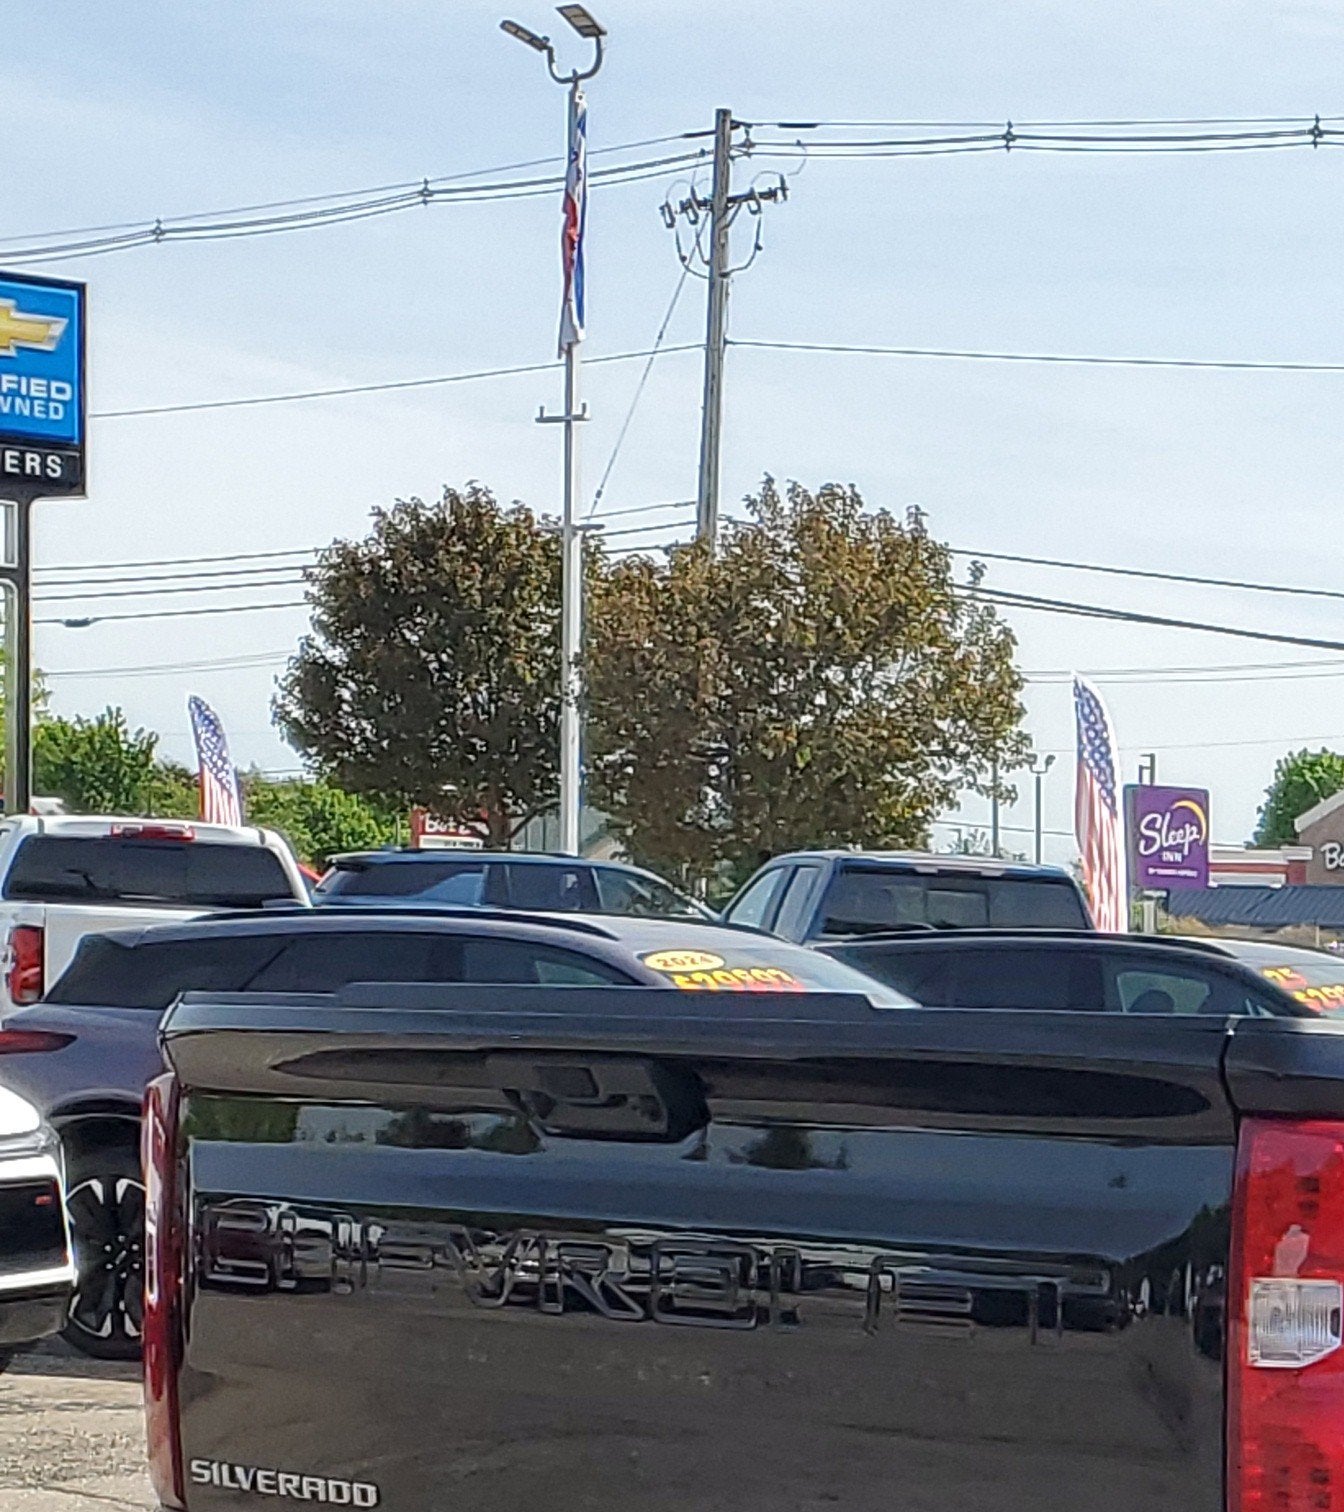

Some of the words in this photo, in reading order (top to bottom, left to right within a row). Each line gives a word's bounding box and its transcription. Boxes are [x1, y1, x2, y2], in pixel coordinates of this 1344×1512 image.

[4, 450, 62, 478] ERS
[1138, 811, 1200, 856] Sleep
[200, 1203, 1118, 1348] CHEVROLET
[190, 1458, 379, 1508] SILVERADO
